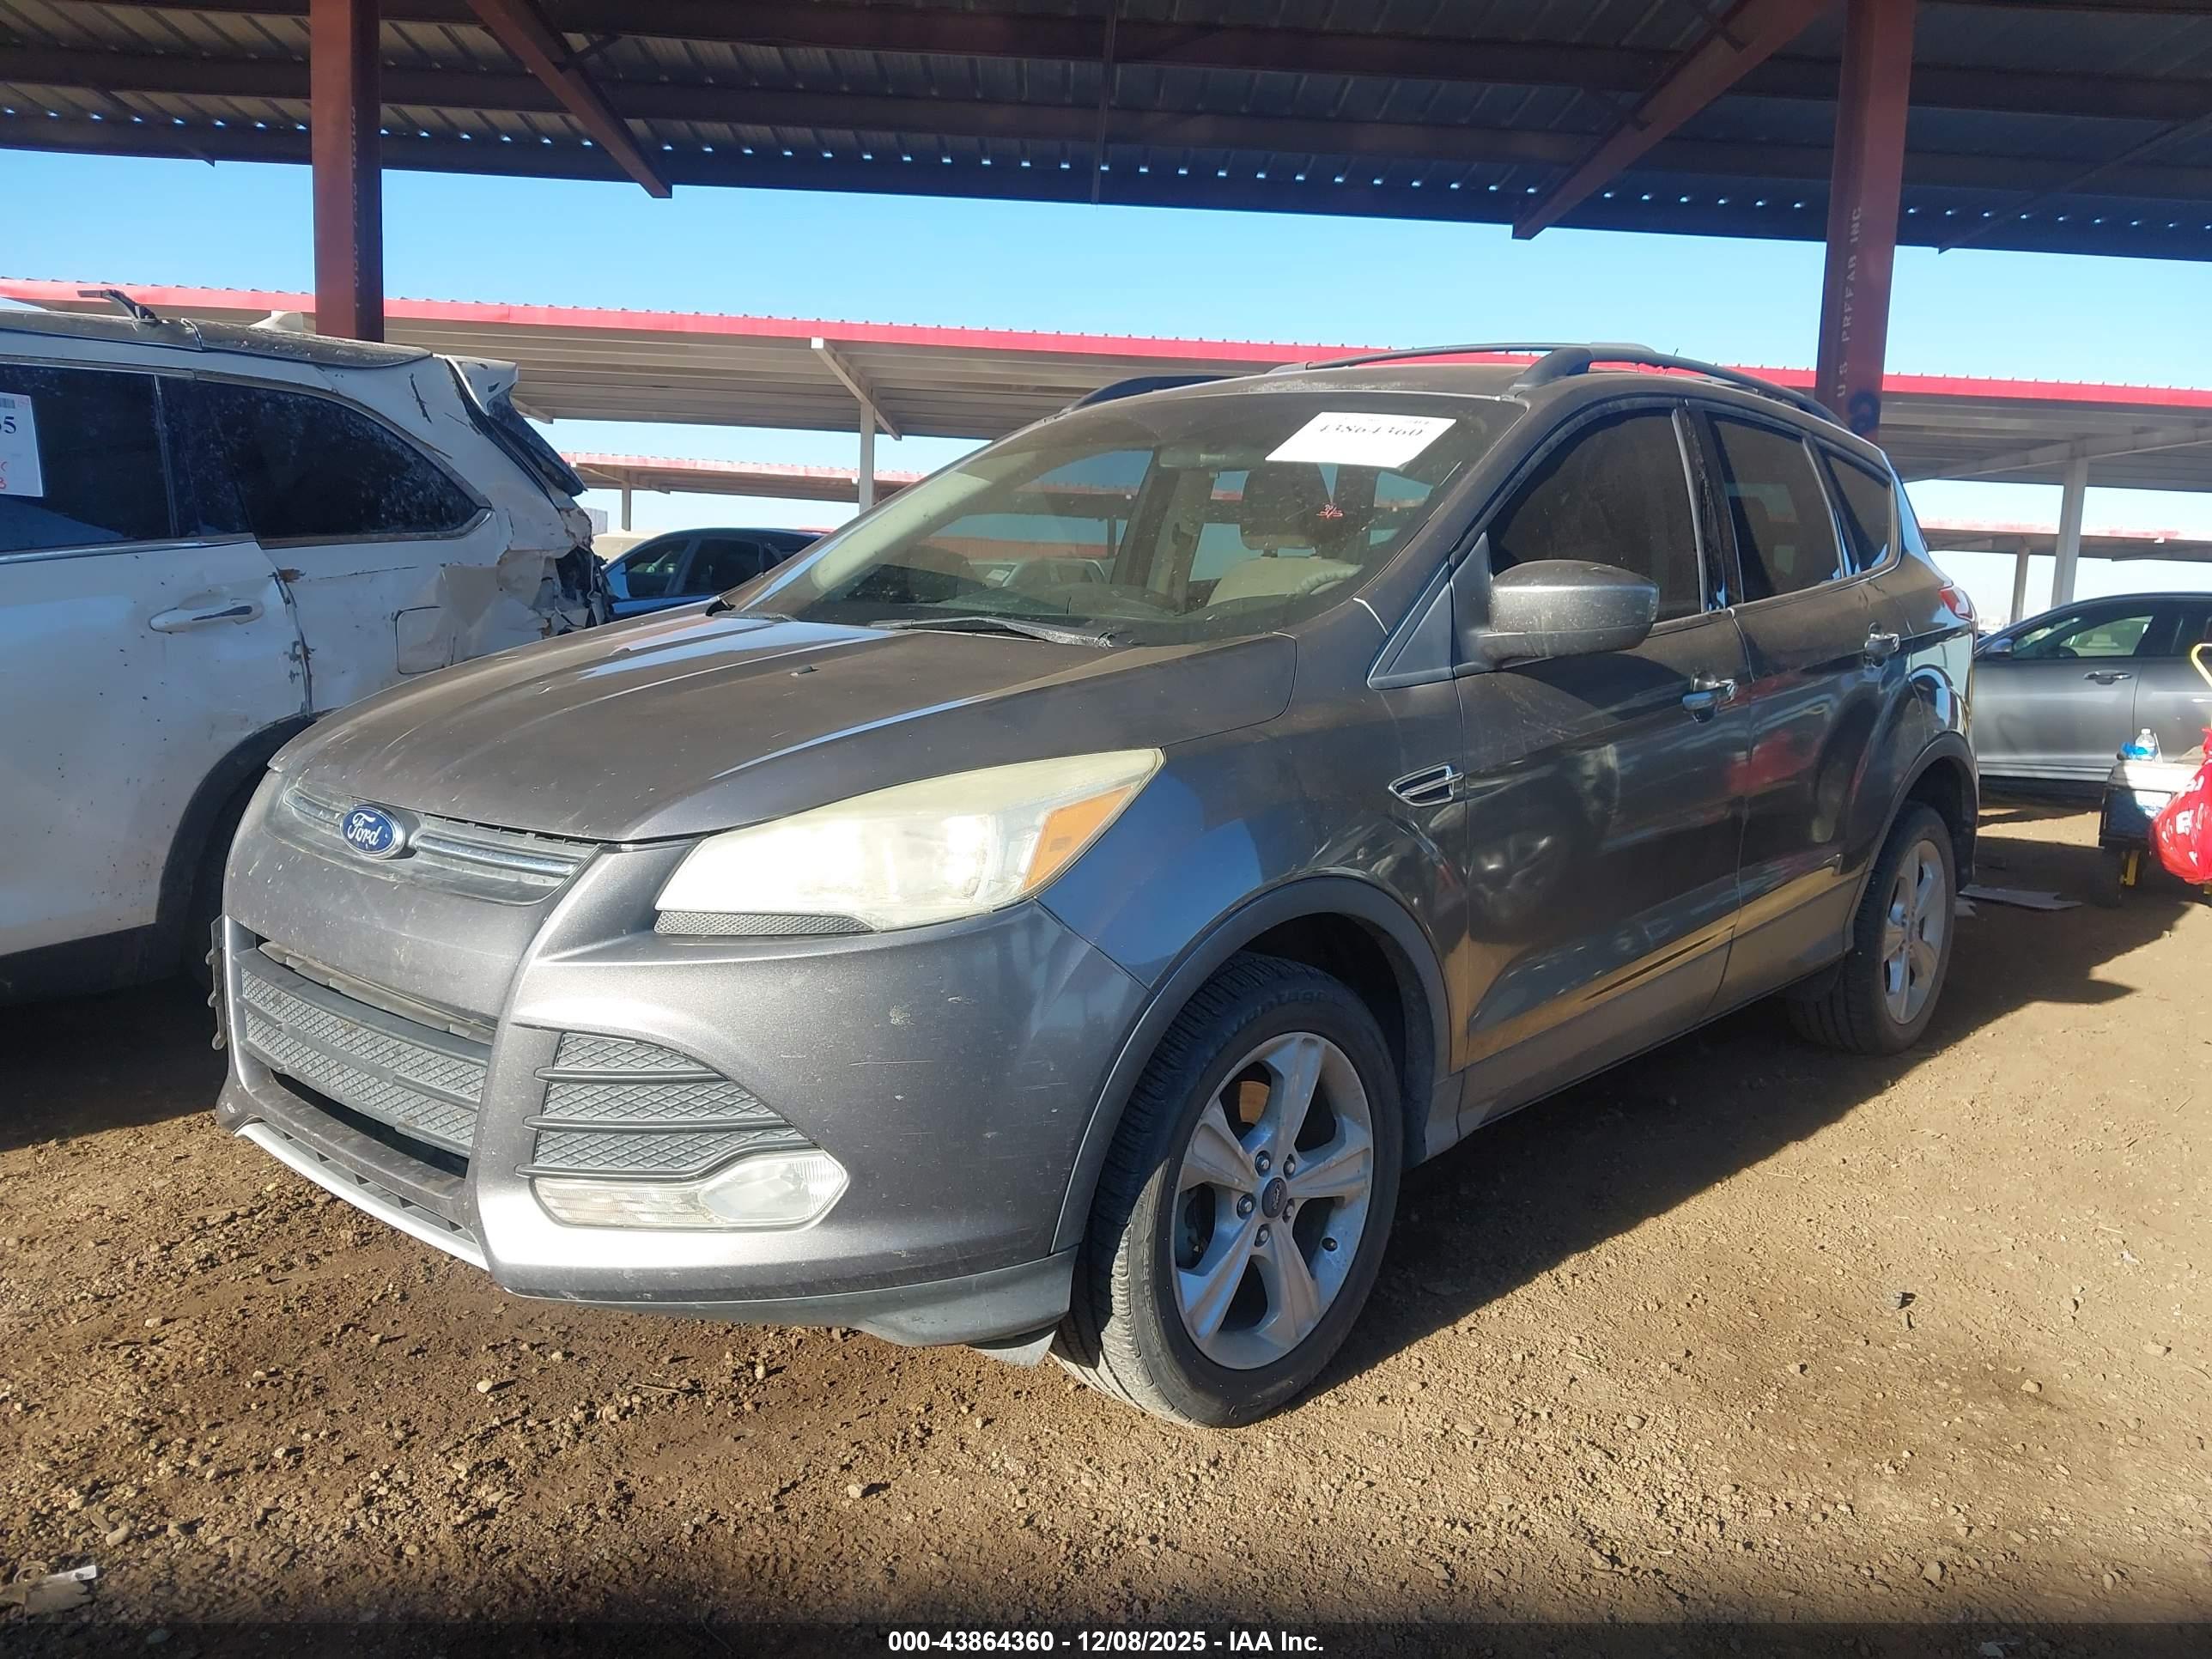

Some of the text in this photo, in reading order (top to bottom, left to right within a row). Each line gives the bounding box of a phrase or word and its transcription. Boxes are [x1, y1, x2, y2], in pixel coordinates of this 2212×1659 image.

[1849, 205, 1863, 243] INC
[0, 416, 16, 434] 5
[347, 811, 384, 847] Ford
